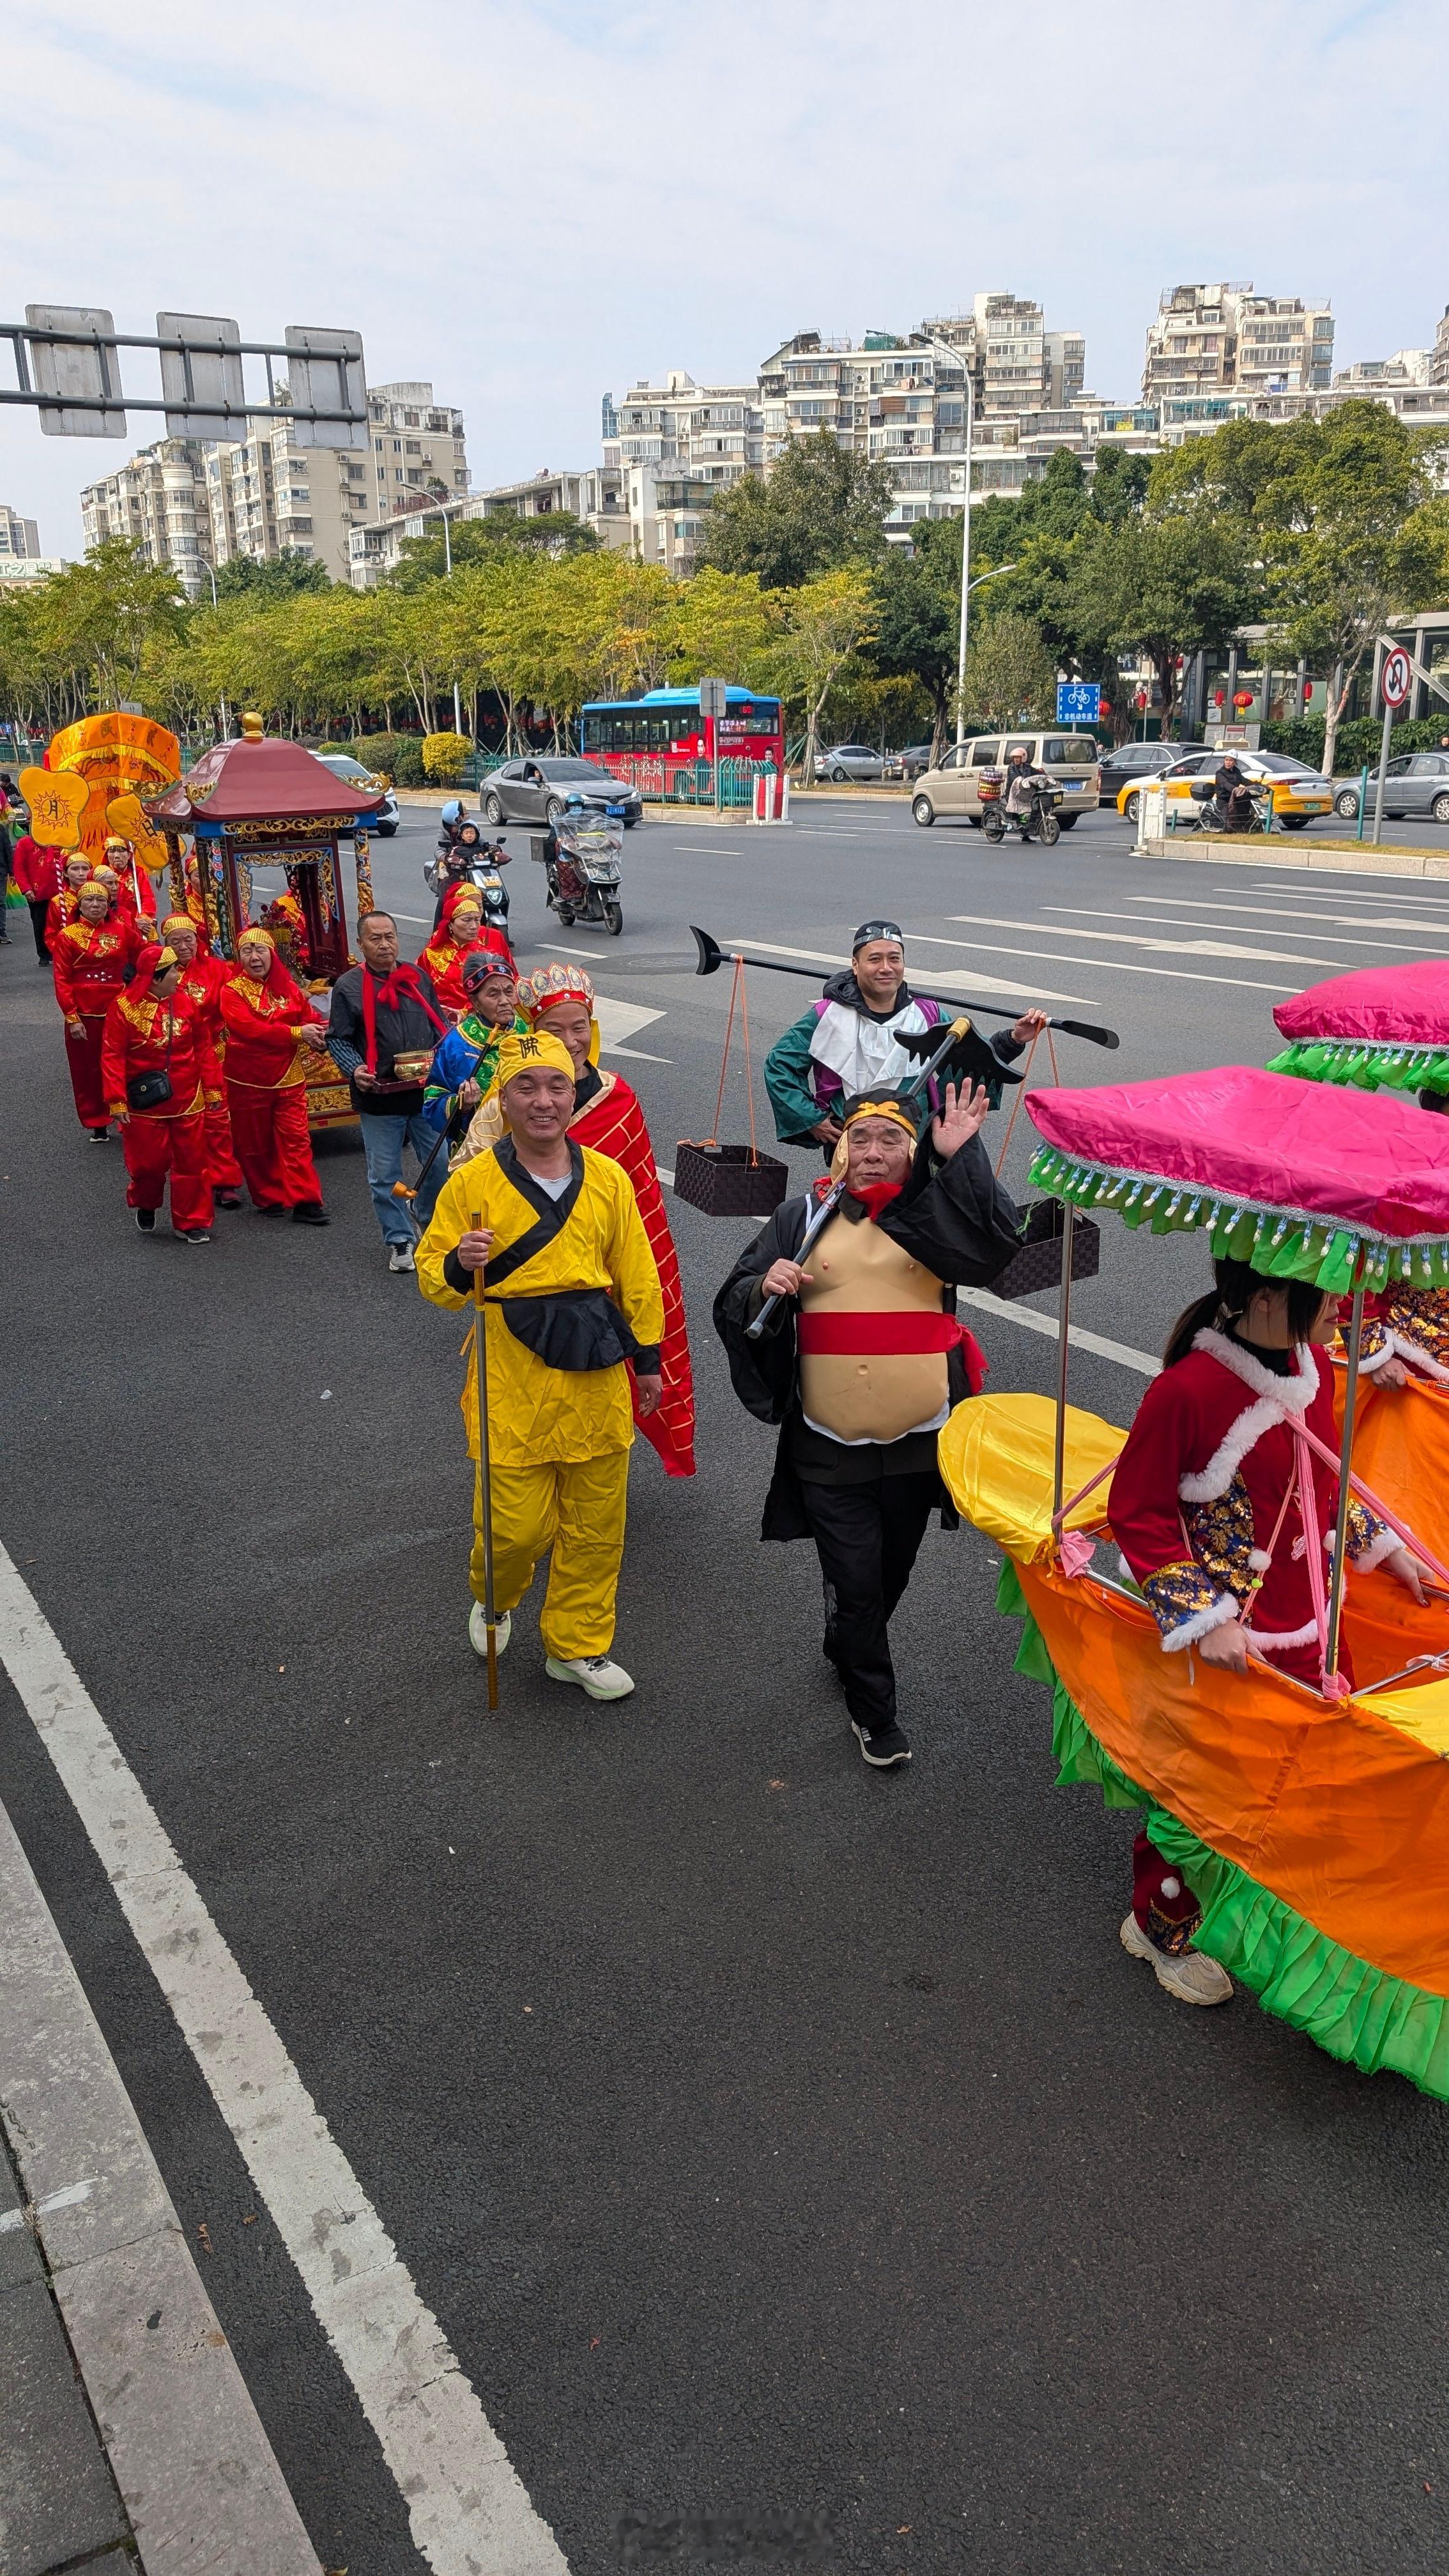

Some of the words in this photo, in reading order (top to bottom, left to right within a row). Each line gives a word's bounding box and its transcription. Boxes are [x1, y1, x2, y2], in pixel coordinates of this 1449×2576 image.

[47, 800, 58, 820] 月
[142, 819, 158, 838] 日
[517, 1036, 542, 1059] 佛
